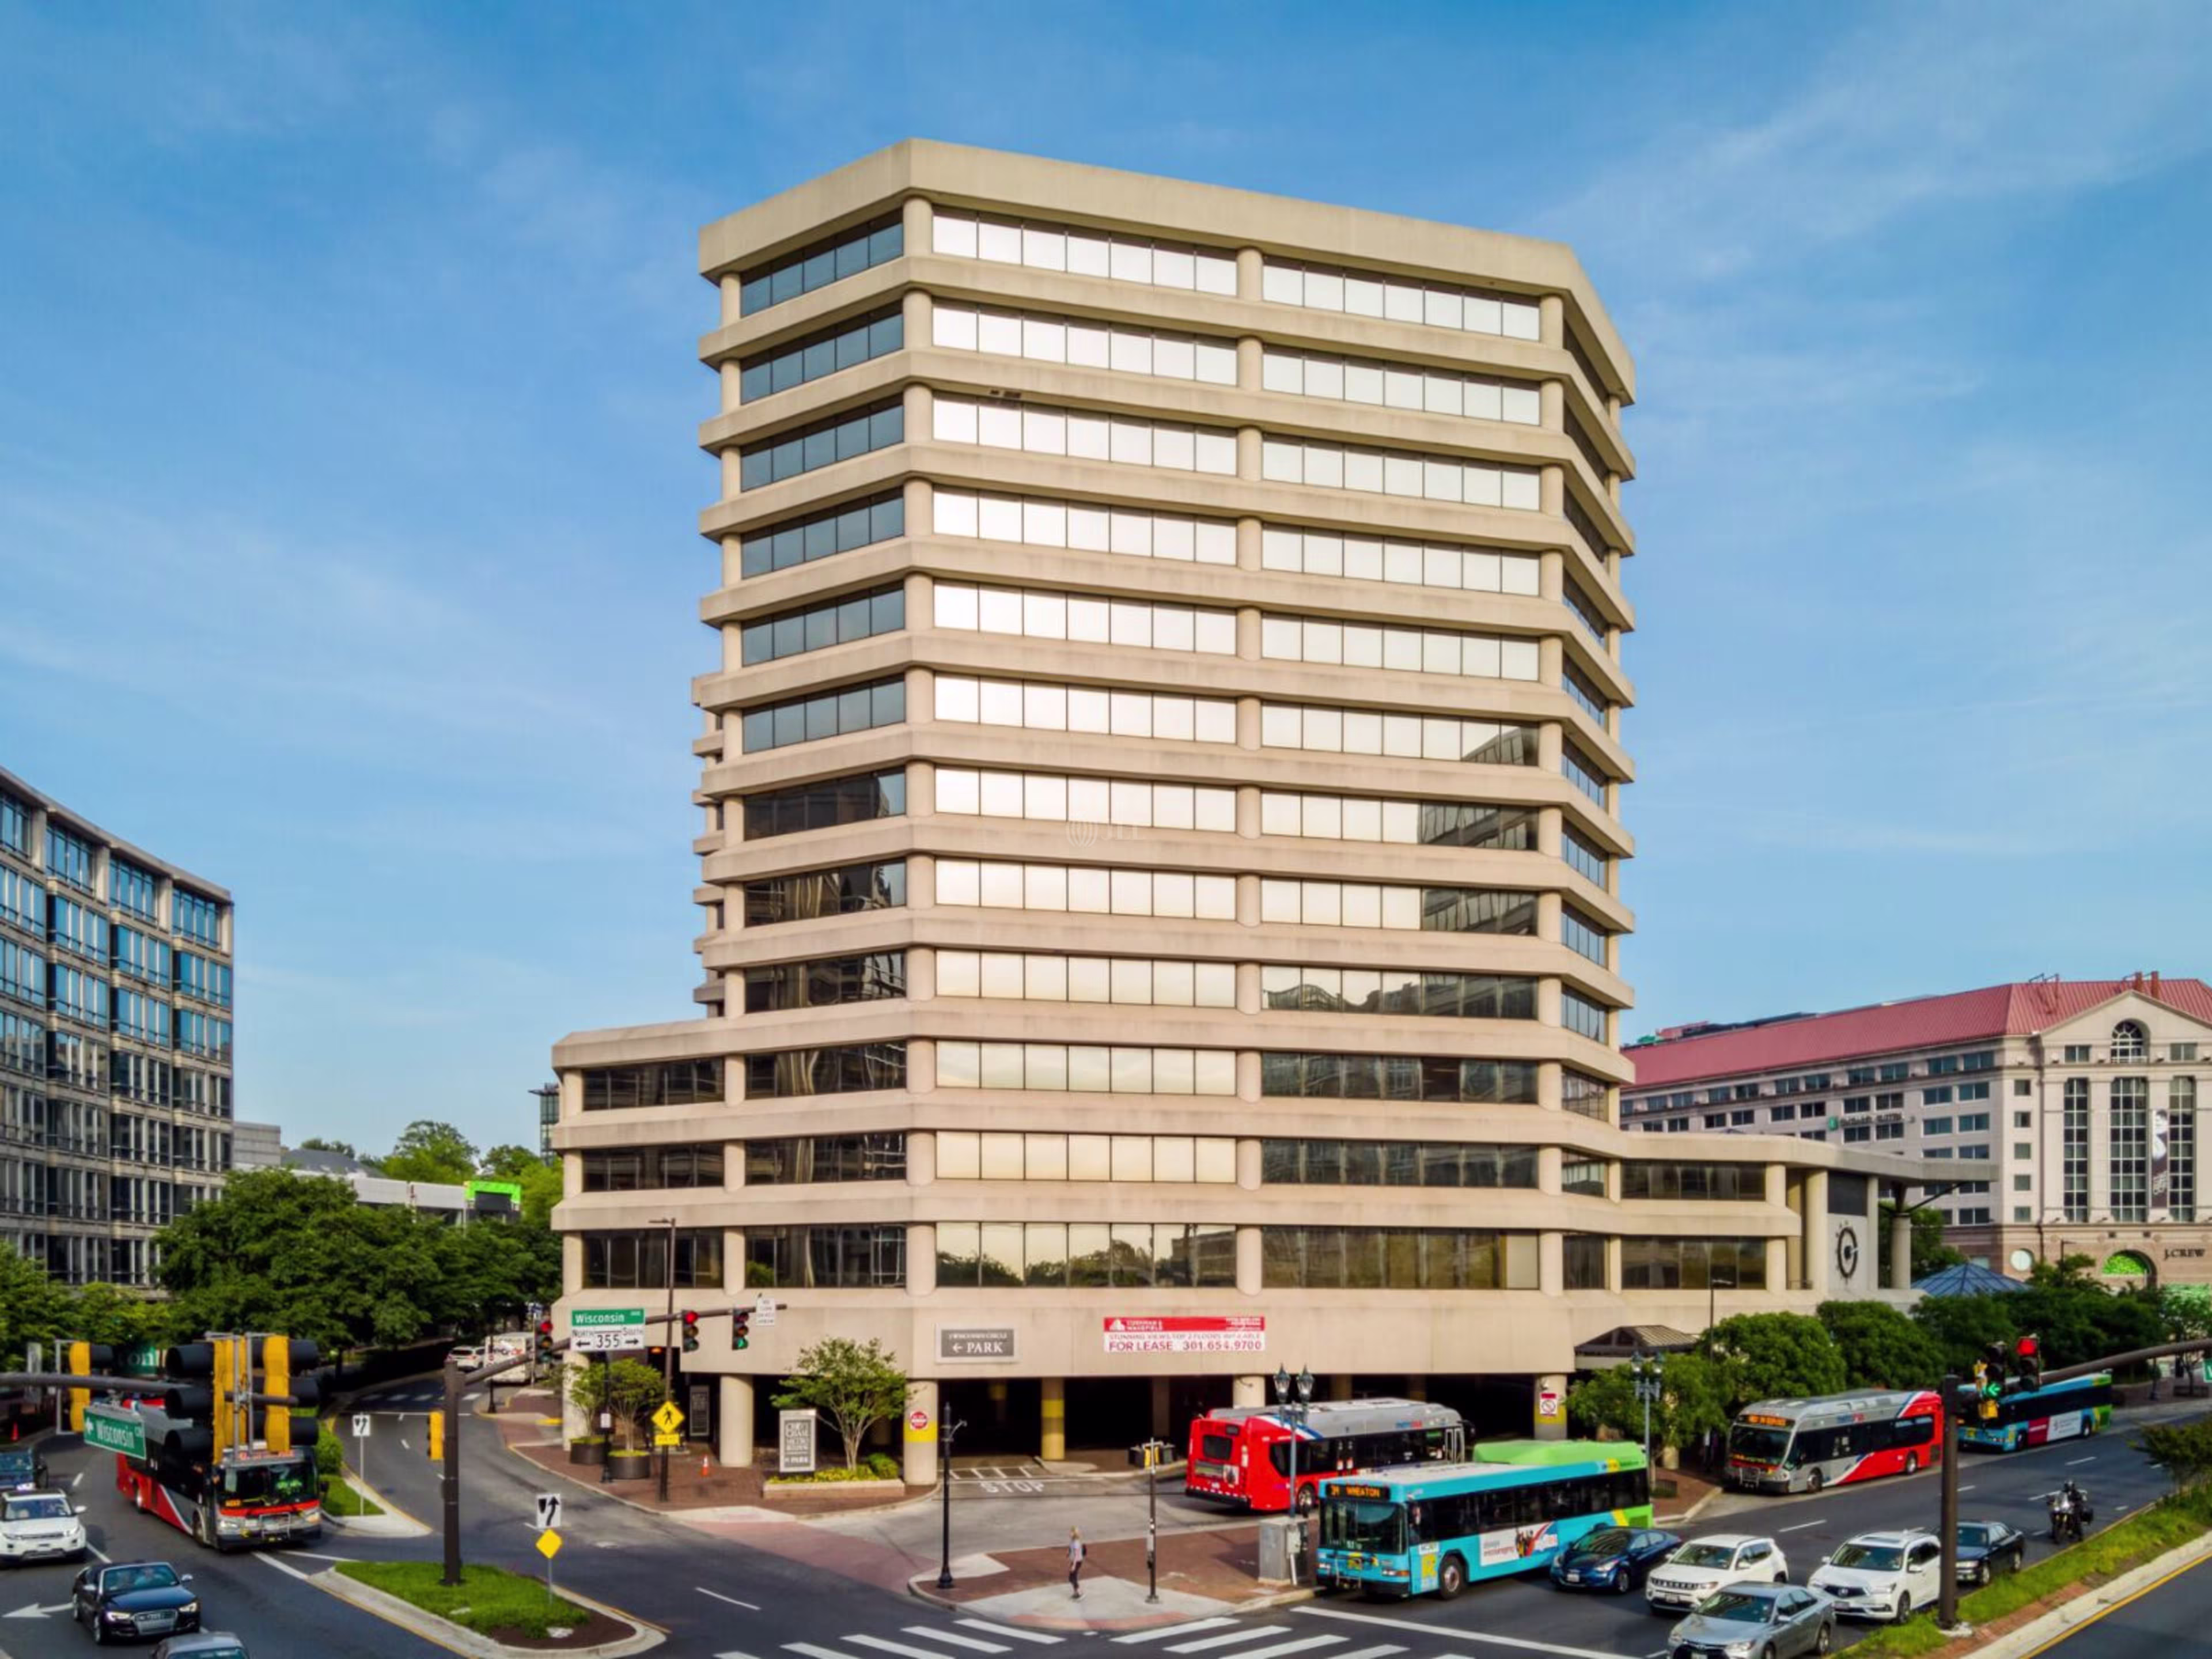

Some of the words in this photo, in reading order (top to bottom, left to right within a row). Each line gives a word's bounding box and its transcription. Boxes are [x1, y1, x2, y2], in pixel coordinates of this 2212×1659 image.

[575, 1312, 625, 1324] Wisconsin
[597, 1334, 619, 1349] 355
[967, 1342, 1003, 1354] PARK
[1109, 1341, 1134, 1351] FOR
[1137, 1341, 1173, 1351] LEASE
[96, 1419, 135, 1449] Wisconsin
[980, 1479, 1044, 1493] STOP
[1346, 1485, 1381, 1498] WHEATON
